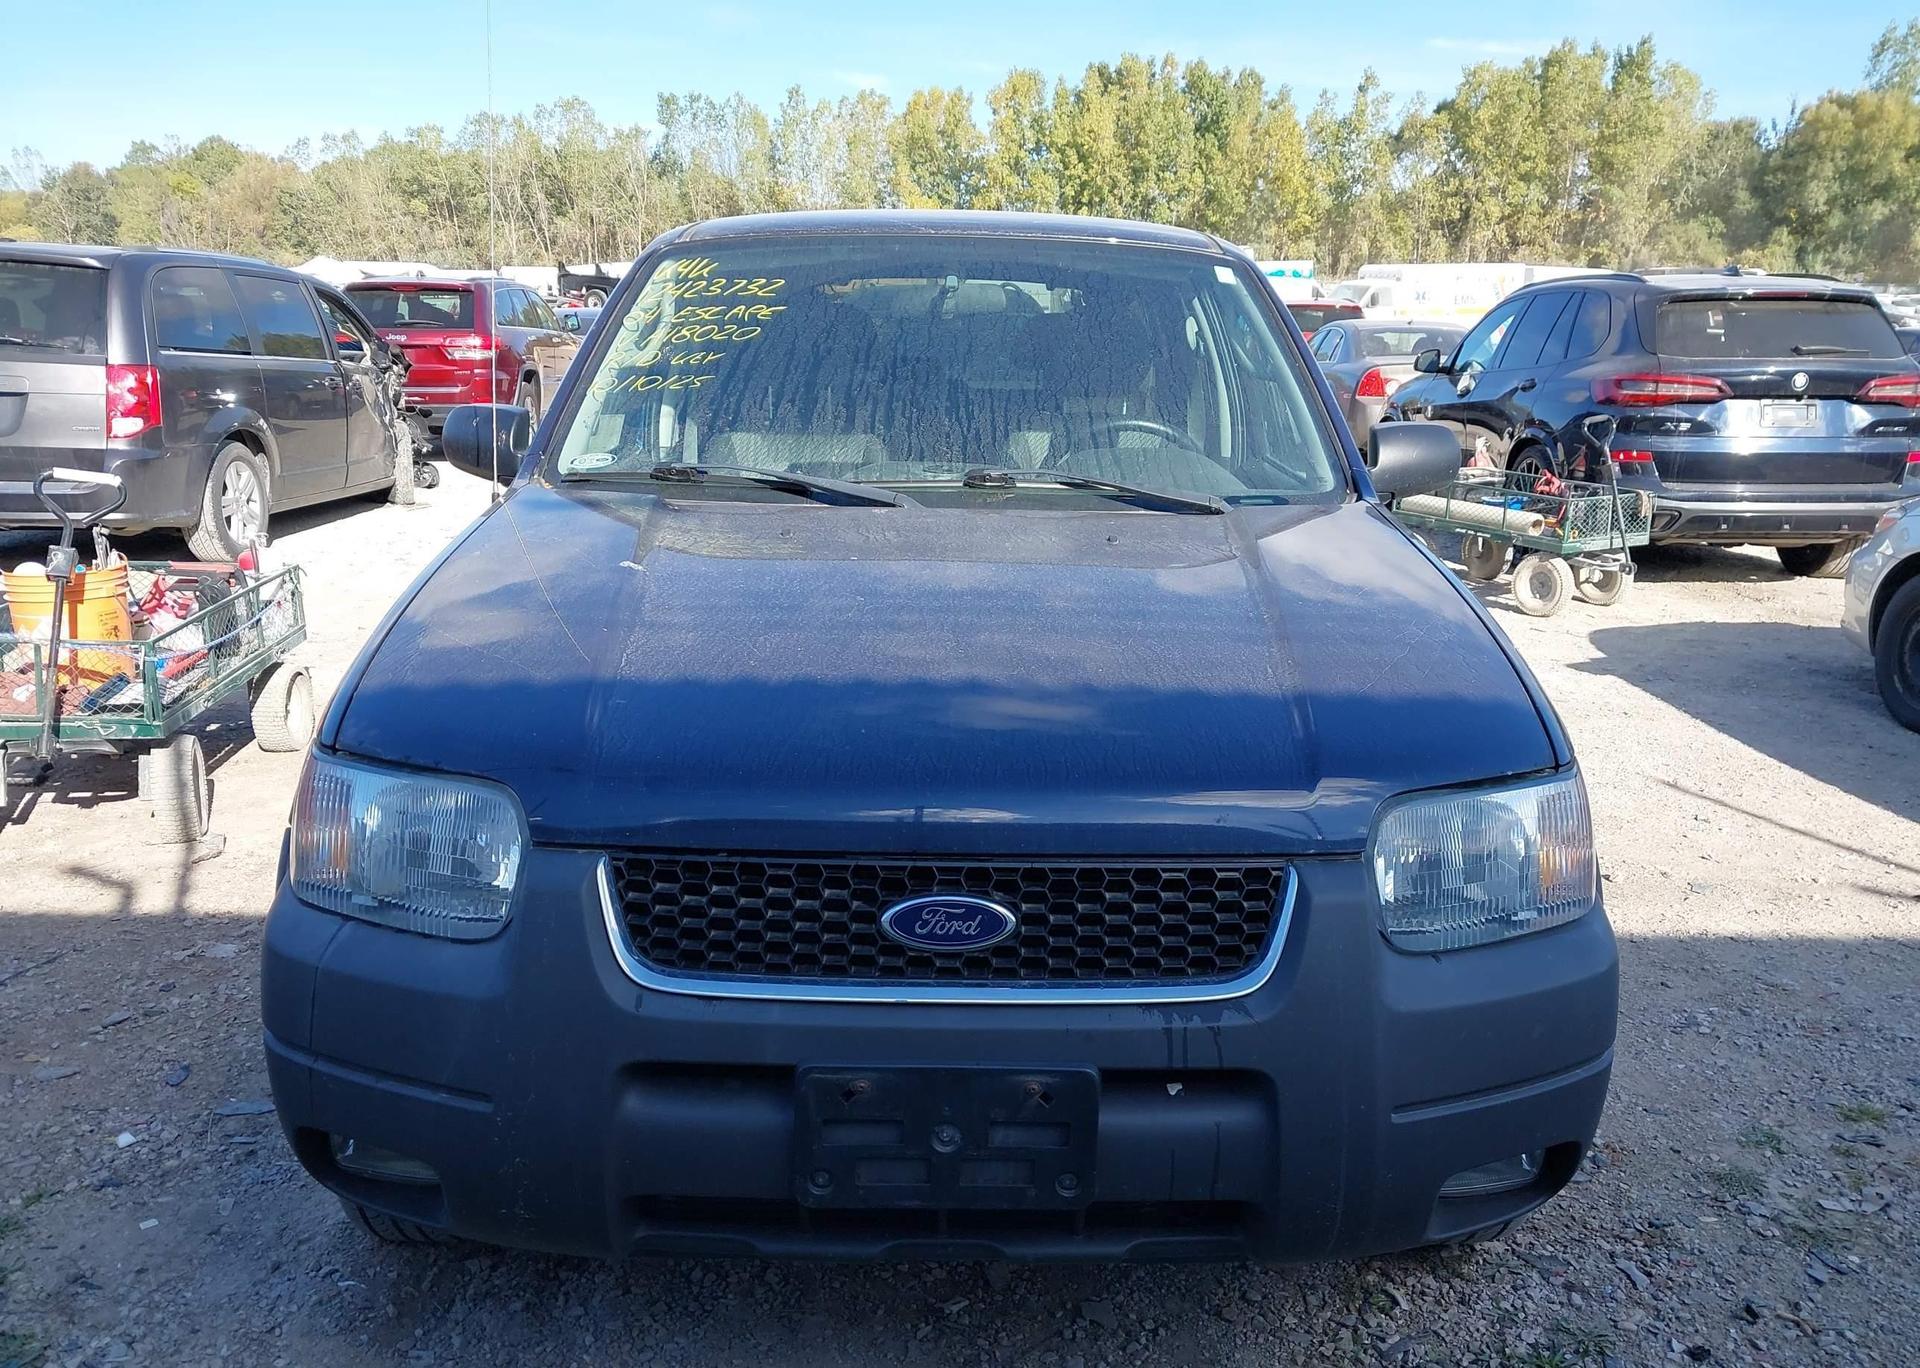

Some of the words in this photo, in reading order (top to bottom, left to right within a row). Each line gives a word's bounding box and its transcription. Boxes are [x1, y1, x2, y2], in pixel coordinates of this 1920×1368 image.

[670, 304, 788, 323] ESCAPE
[385, 333, 407, 342] Jeep
[1659, 422, 1692, 431] X5
[914, 906, 982, 935] Ford
